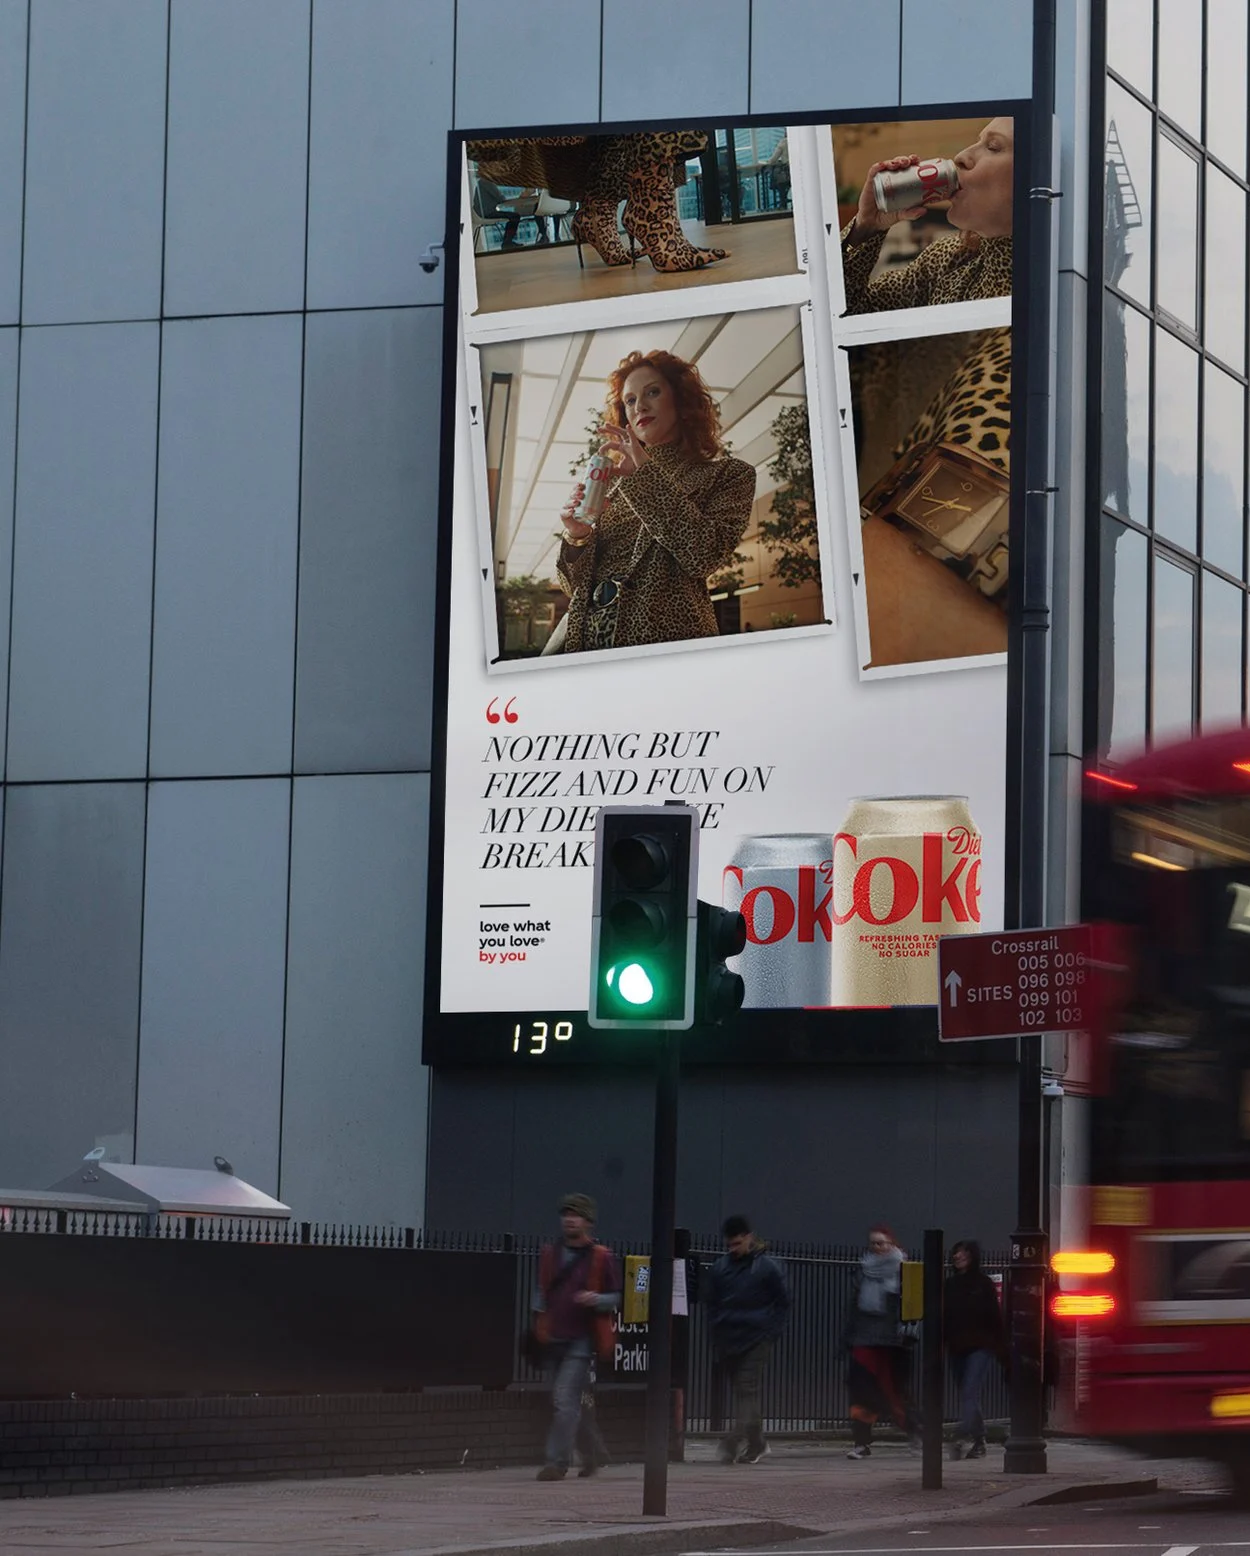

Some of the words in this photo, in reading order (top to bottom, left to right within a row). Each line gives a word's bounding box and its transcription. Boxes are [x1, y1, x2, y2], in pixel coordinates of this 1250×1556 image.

[481, 733, 641, 763] NOTHING
[645, 731, 720, 759] BUT
[480, 771, 562, 799] FIZZ
[562, 769, 639, 797] AND
[643, 767, 720, 795] FUN
[723, 765, 776, 793] ON
[479, 806, 538, 834] MY
[537, 804, 603, 833] DIE
[480, 921, 510, 932] love
[513, 920, 551, 932] what
[479, 938, 506, 950] you
[859, 934, 920, 942] REFRESHING
[922, 934, 950, 942] TAS
[887, 942, 937, 950] CALORIES
[991, 936, 1059, 955] Crossrail
[479, 951, 497, 964] by
[499, 951, 526, 964] you
[878, 950, 893, 958] NO
[895, 950, 930, 958] SUGAR
[1018, 955, 1048, 971] 005
[1054, 952, 1085, 968] 006
[1018, 973, 1049, 990] 096
[1054, 970, 1085, 986] 098
[967, 985, 1013, 1003] SITES
[1019, 991, 1049, 1008] 099
[1055, 989, 1078, 1005] 101
[1019, 1010, 1046, 1026] 102
[1055, 1008, 1082, 1023] 103
[614, 1343, 649, 1371] Parki
